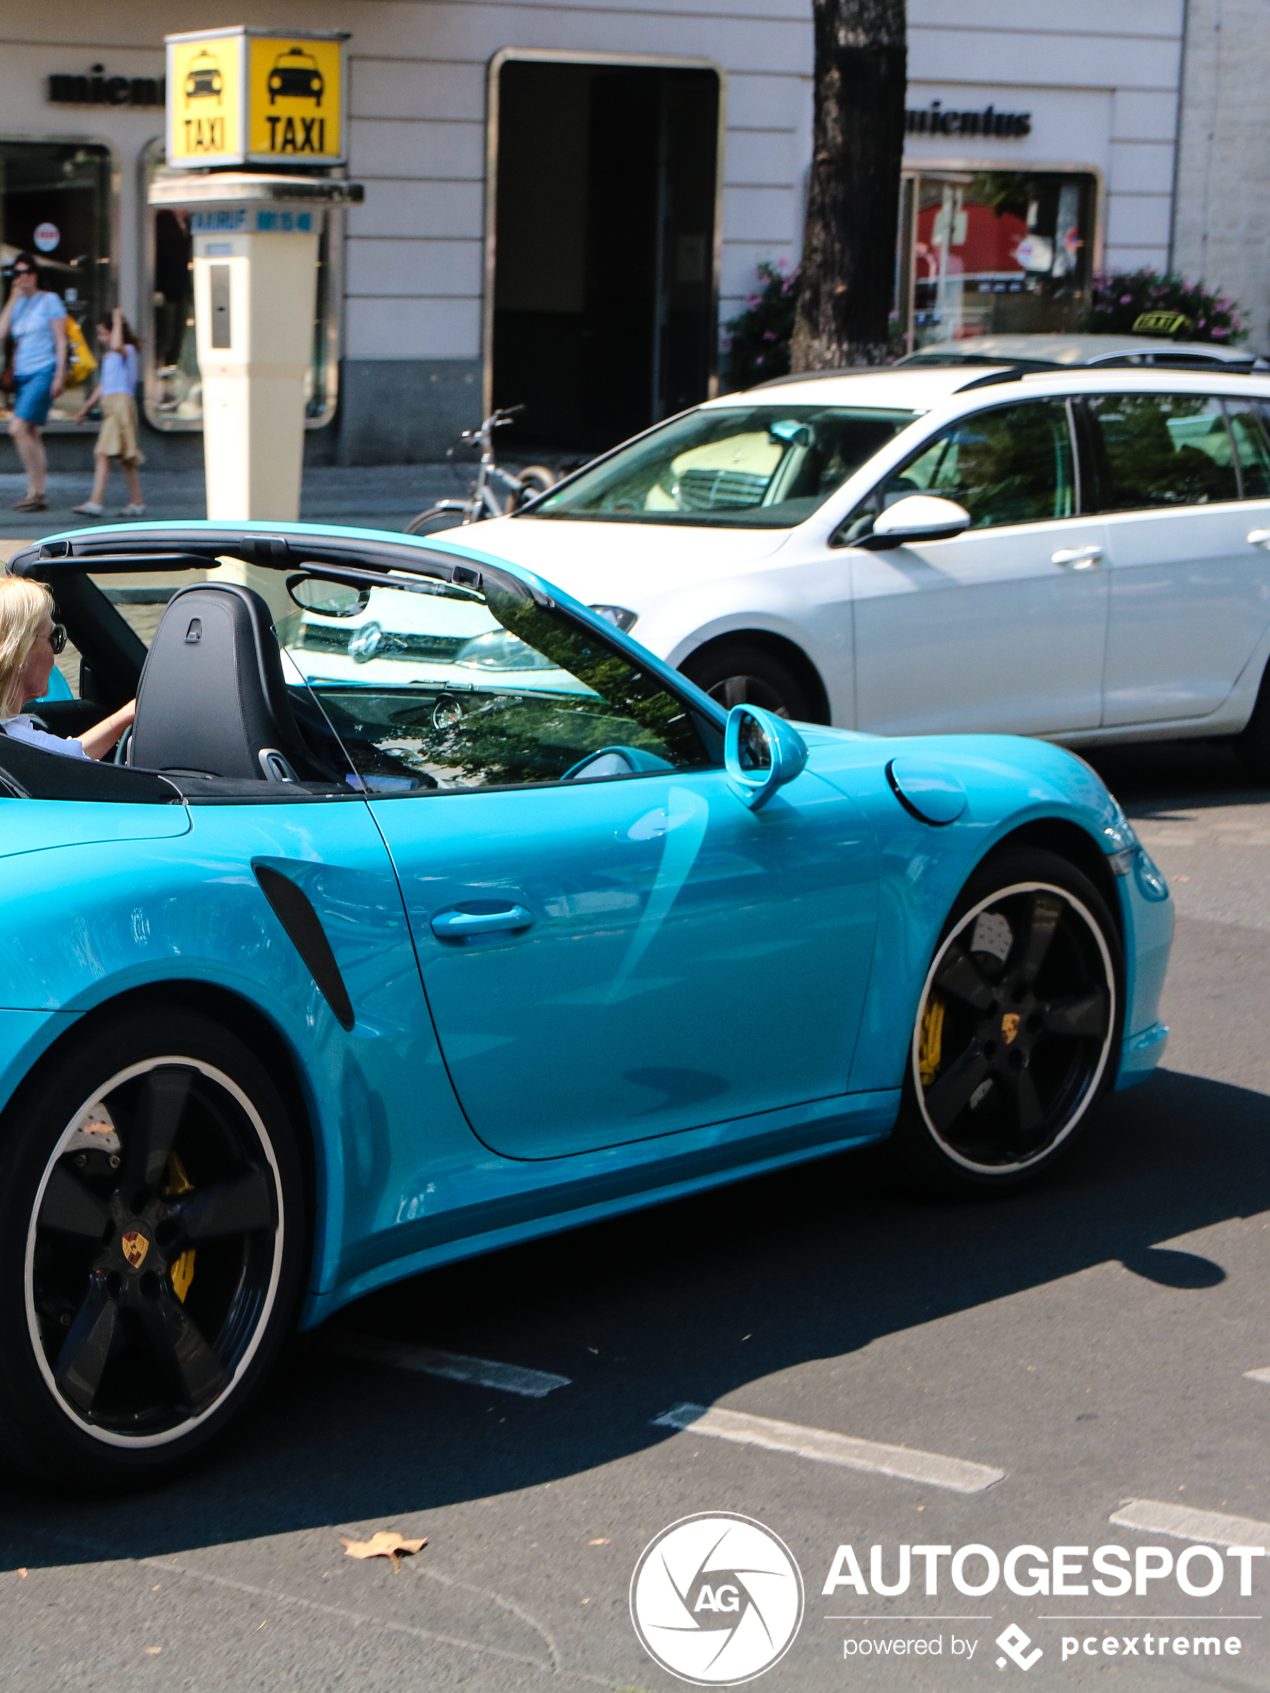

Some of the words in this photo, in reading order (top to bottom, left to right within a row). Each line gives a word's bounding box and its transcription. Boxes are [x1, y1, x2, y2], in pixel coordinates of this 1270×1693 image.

[47, 63, 166, 106] mien
[183, 116, 225, 153] TAXI
[266, 116, 325, 153] TAXI
